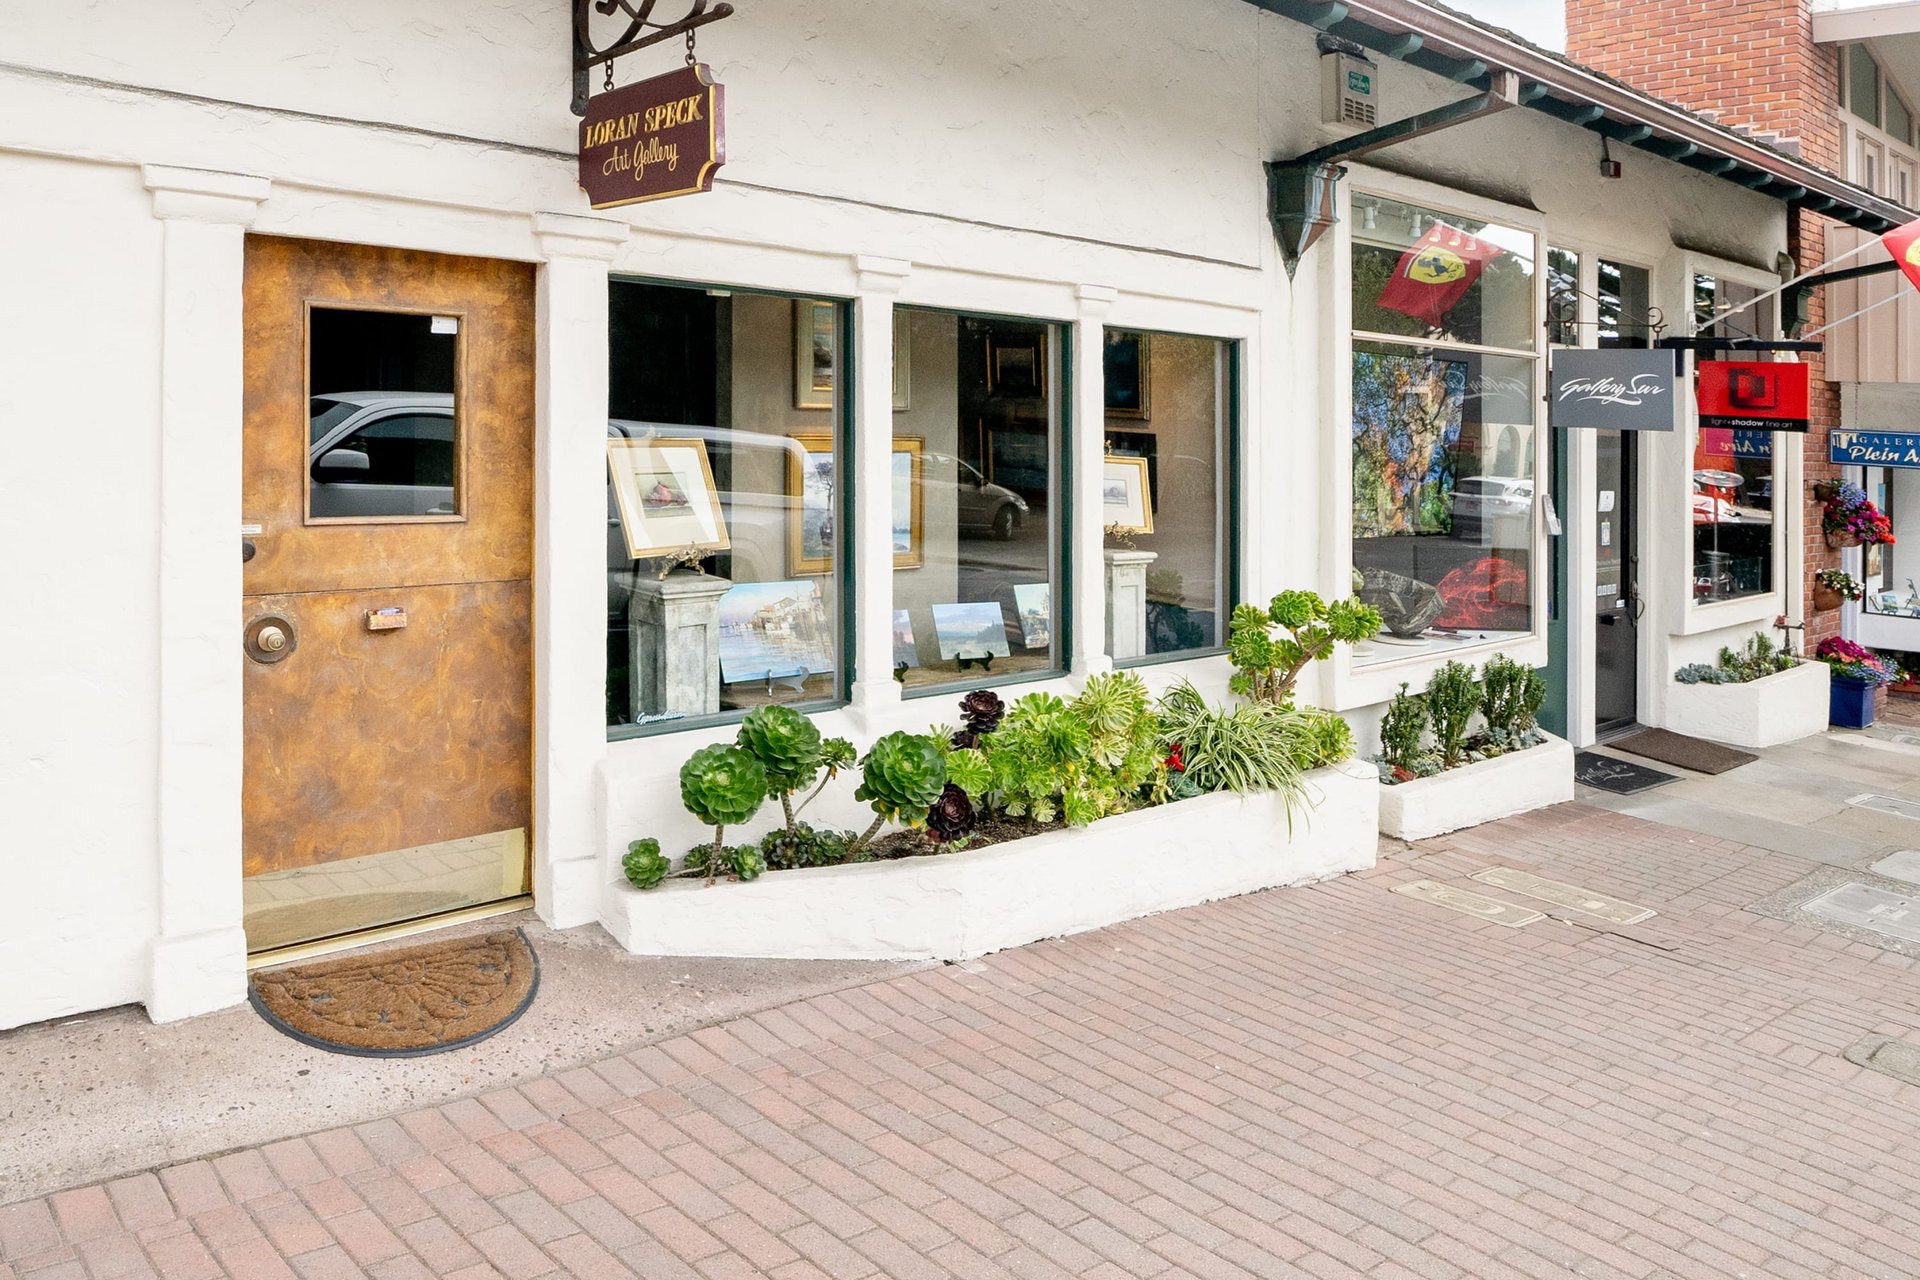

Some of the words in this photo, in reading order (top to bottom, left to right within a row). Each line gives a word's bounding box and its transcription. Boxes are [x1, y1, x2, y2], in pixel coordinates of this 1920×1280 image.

[584, 112, 640, 149] LORAN
[644, 93, 704, 133] SPECK
[602, 145, 631, 176] Art
[633, 136, 679, 181] Gallery
[1559, 377, 1627, 405] Gallery
[1626, 373, 1666, 395] Sur
[1849, 445, 1900, 462] Plein
[1859, 436, 1920, 446] GALER
